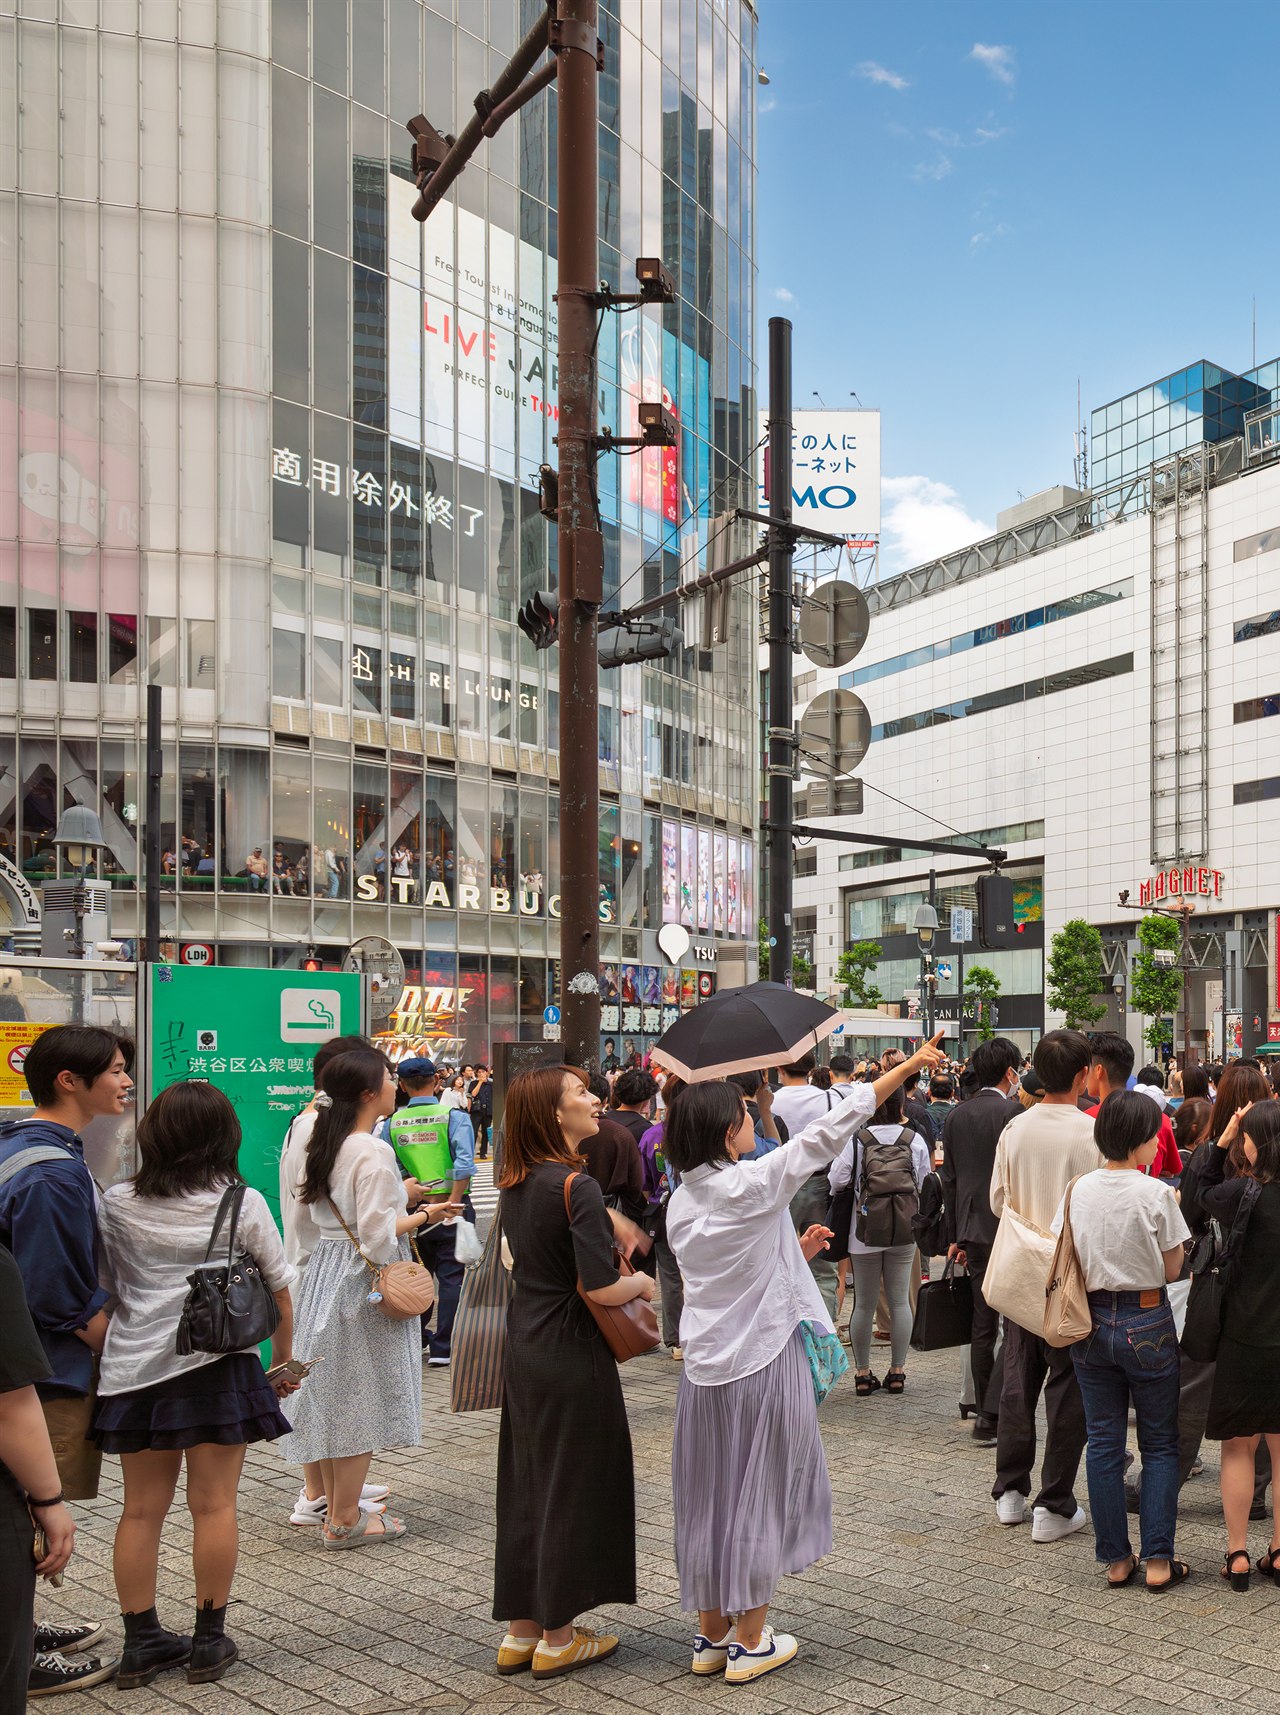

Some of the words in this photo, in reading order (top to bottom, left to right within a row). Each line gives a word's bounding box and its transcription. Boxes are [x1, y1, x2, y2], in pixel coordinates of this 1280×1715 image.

[424, 301, 496, 362] LIVE
[272, 447, 484, 537] 適用除外終了
[356, 874, 614, 924] STARBUCS
[1139, 866, 1225, 907] MAGNET
[187, 950, 207, 960] LDH
[694, 946, 718, 960] TSU
